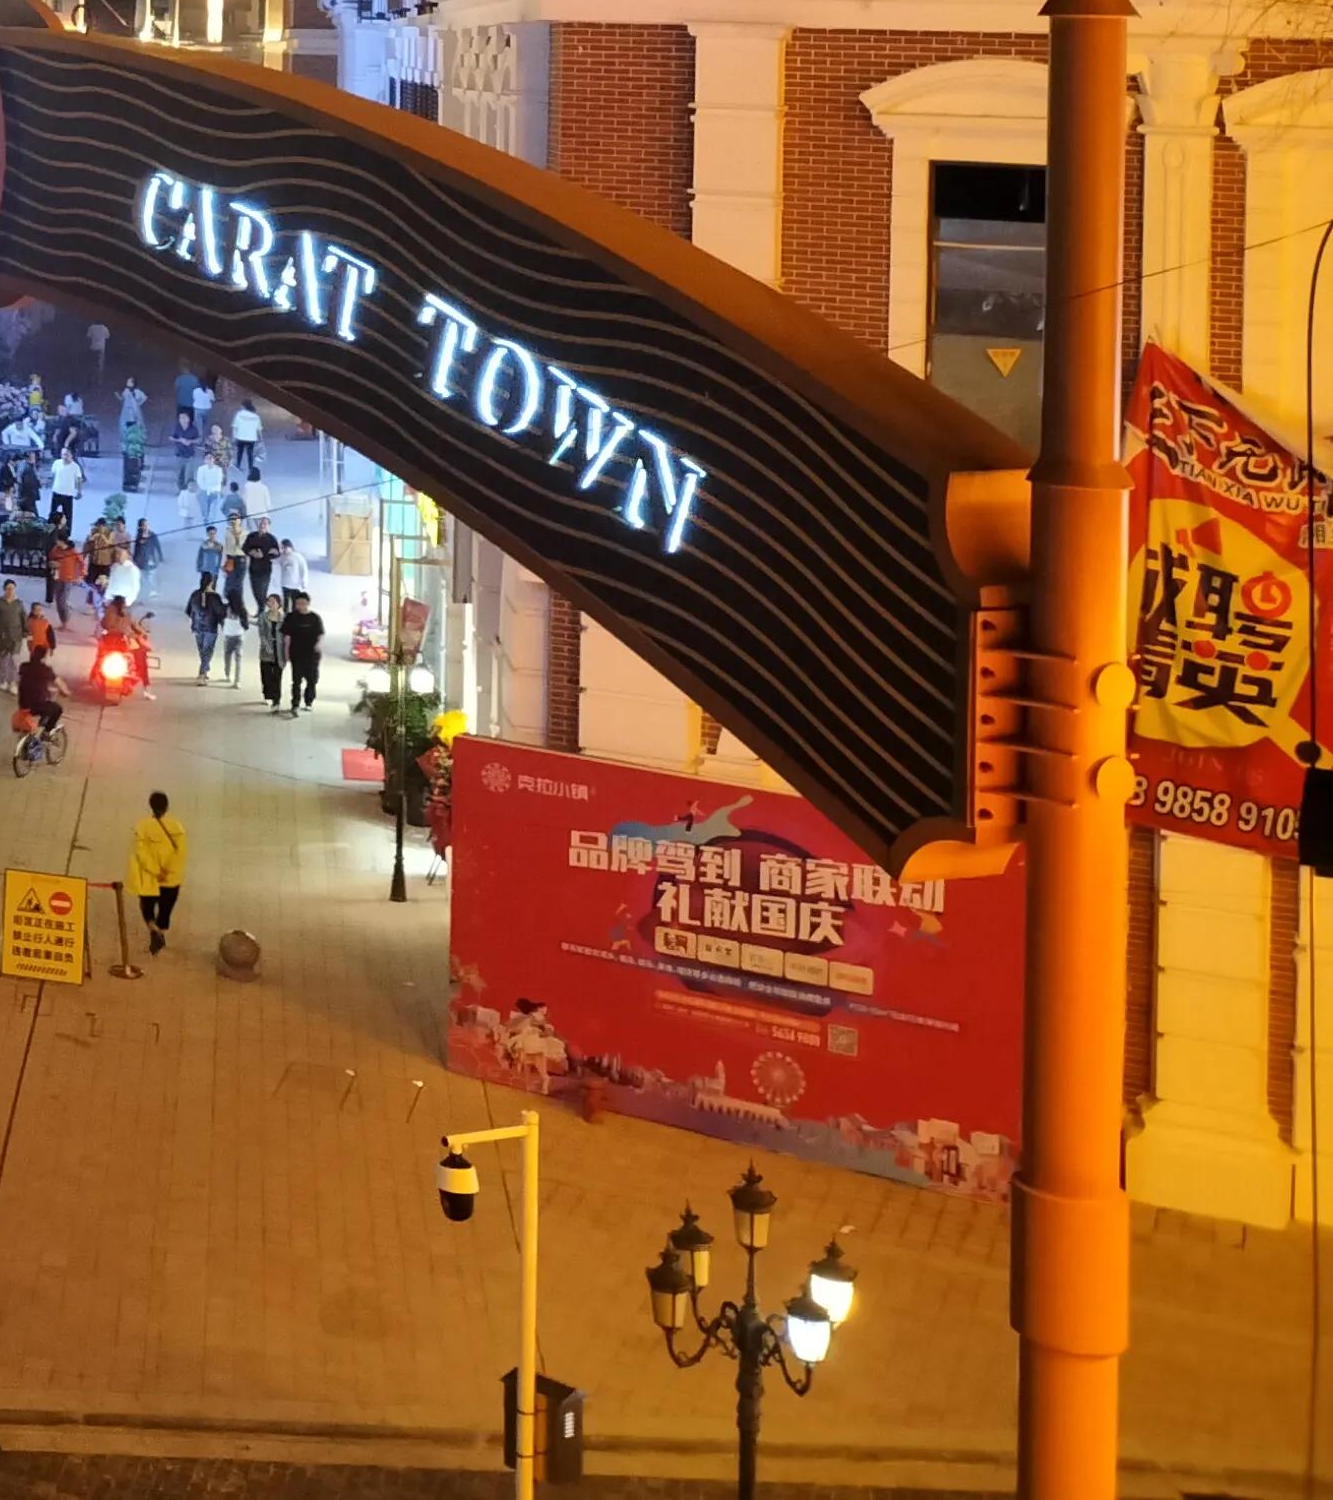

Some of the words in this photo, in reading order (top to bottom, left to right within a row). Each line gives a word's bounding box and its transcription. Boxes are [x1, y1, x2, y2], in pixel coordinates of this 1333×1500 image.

[142, 170, 376, 342] CARAT
[416, 293, 707, 554] TOWN
[1153, 779, 1232, 828] 9858
[1237, 800, 1300, 842] 910
[568, 829, 742, 888] 品牌驾到
[759, 850, 946, 914] 商家联动
[656, 881, 845, 947] 礼献国庆
